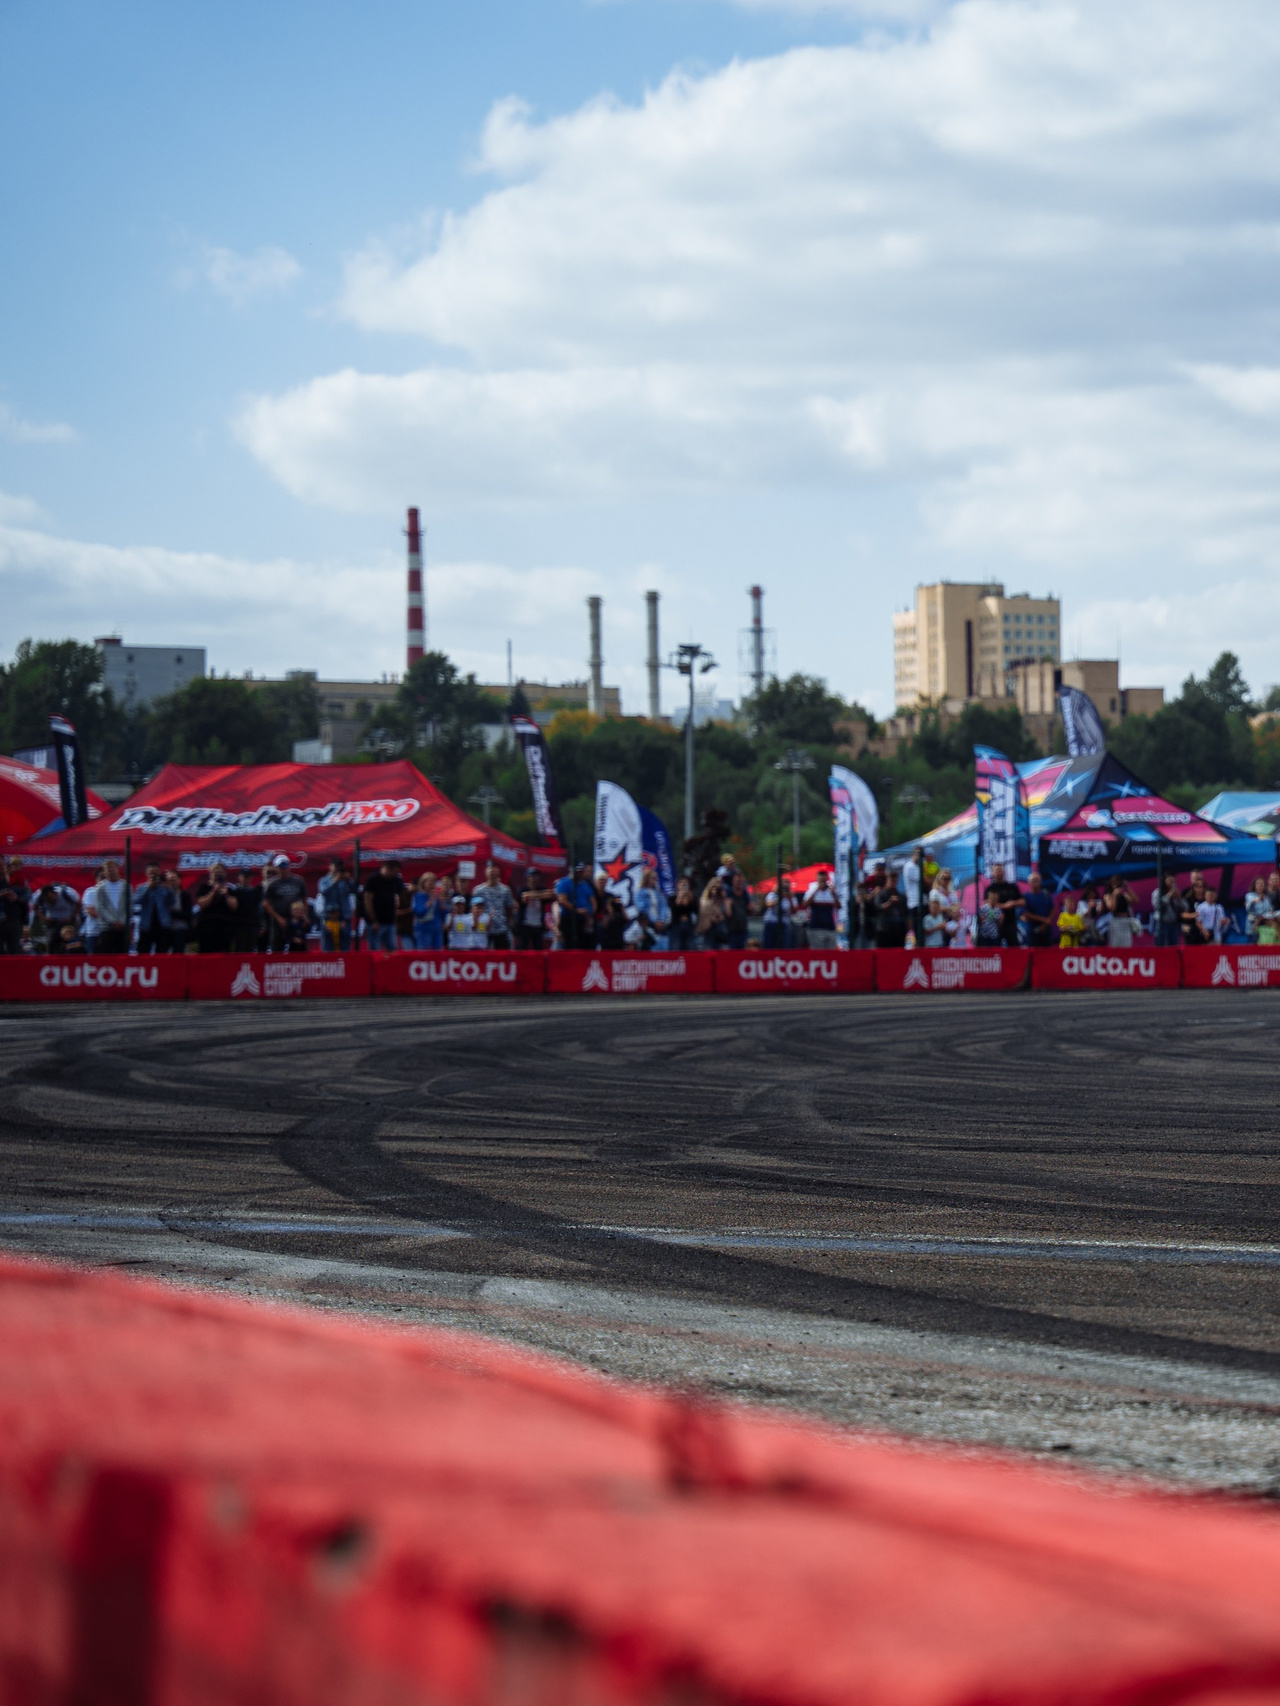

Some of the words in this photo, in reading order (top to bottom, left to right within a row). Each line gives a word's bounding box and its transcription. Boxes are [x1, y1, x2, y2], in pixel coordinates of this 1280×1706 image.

[40, 963, 158, 987] auto.ru
[264, 958, 345, 979] МОСКОВСКИЙ
[409, 958, 517, 982] auto.ru
[739, 956, 838, 979] auto.ru
[1062, 953, 1155, 978] auto.ru
[264, 978, 303, 997] СПОРТ
[612, 974, 650, 992] СПОРТ
[931, 972, 966, 989] СПОРТ
[1237, 969, 1269, 987] СПОРТ
